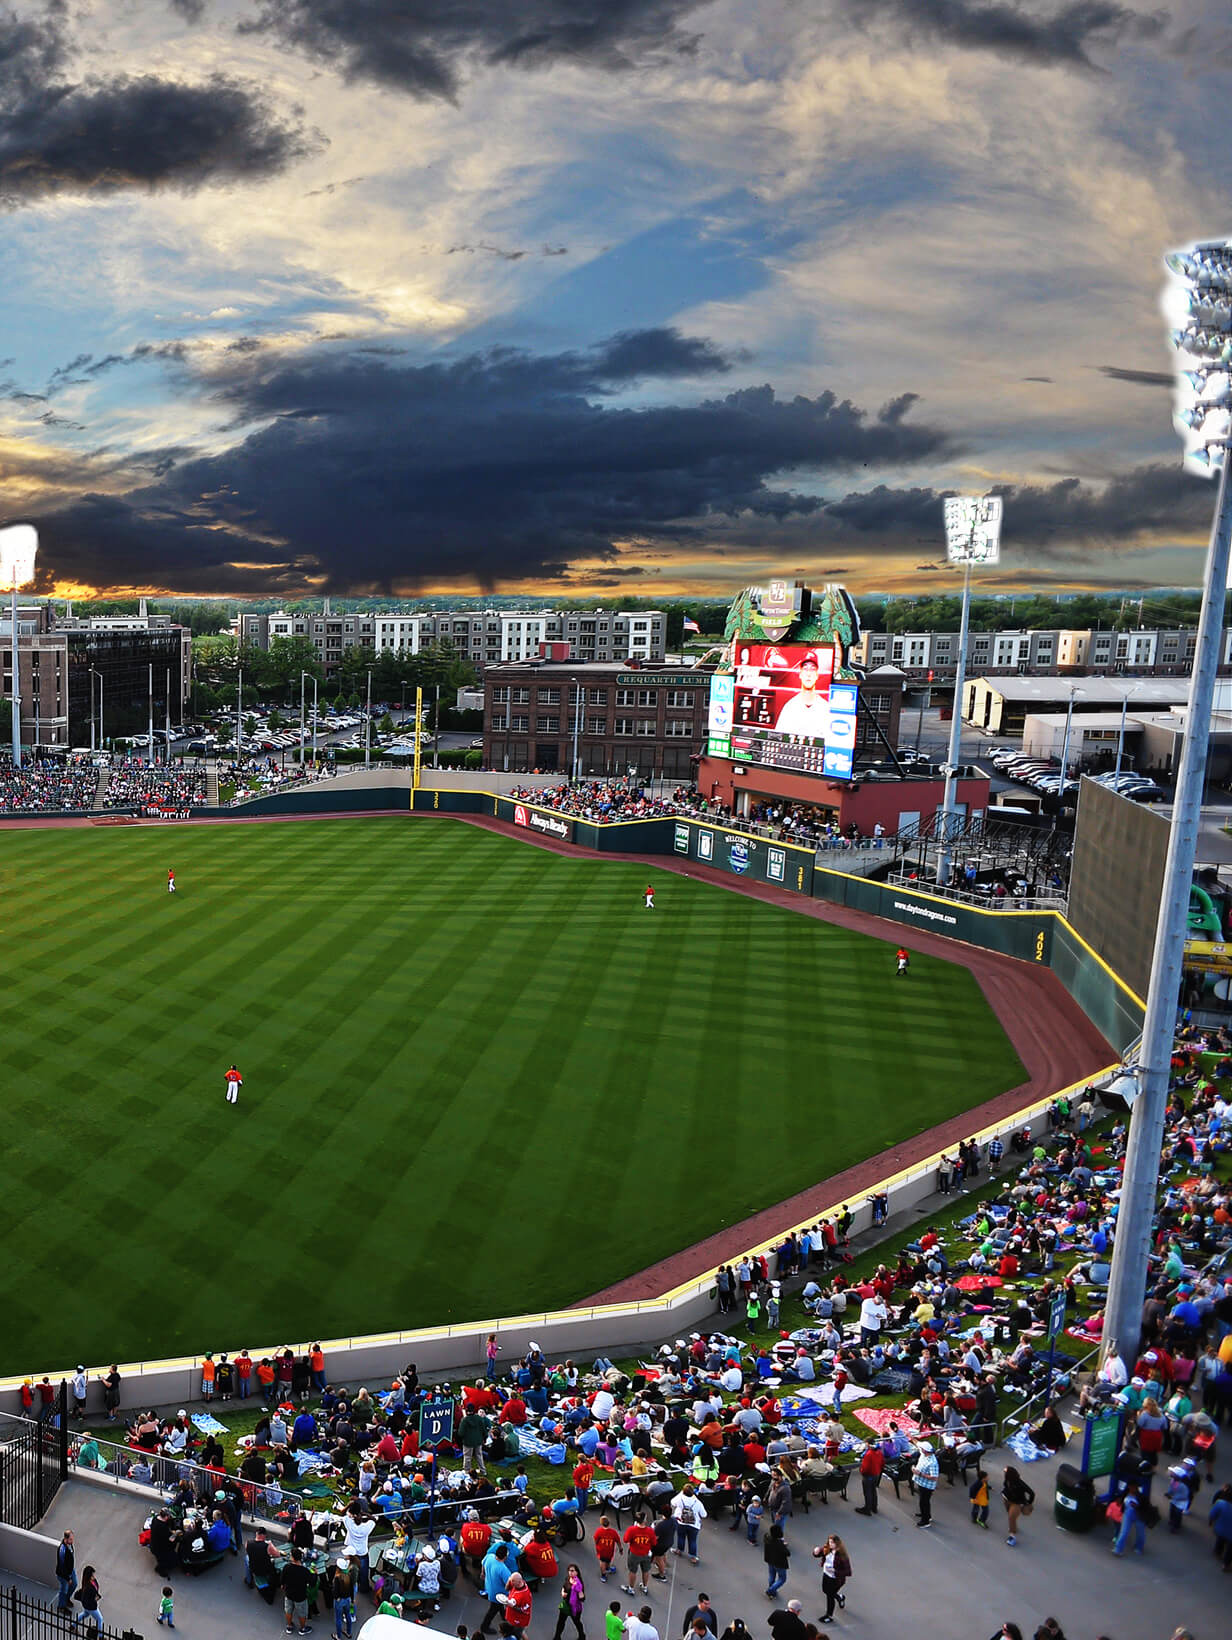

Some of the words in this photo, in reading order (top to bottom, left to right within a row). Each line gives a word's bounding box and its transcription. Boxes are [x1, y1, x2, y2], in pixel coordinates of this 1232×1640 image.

[725, 835, 749, 846] WELCOME
[749, 840, 757, 850] TO
[894, 901, 957, 924] www.daytondragons.com
[1035, 931, 1044, 960] 402
[424, 1408, 451, 1419] LAWN
[432, 1420, 441, 1435] D
